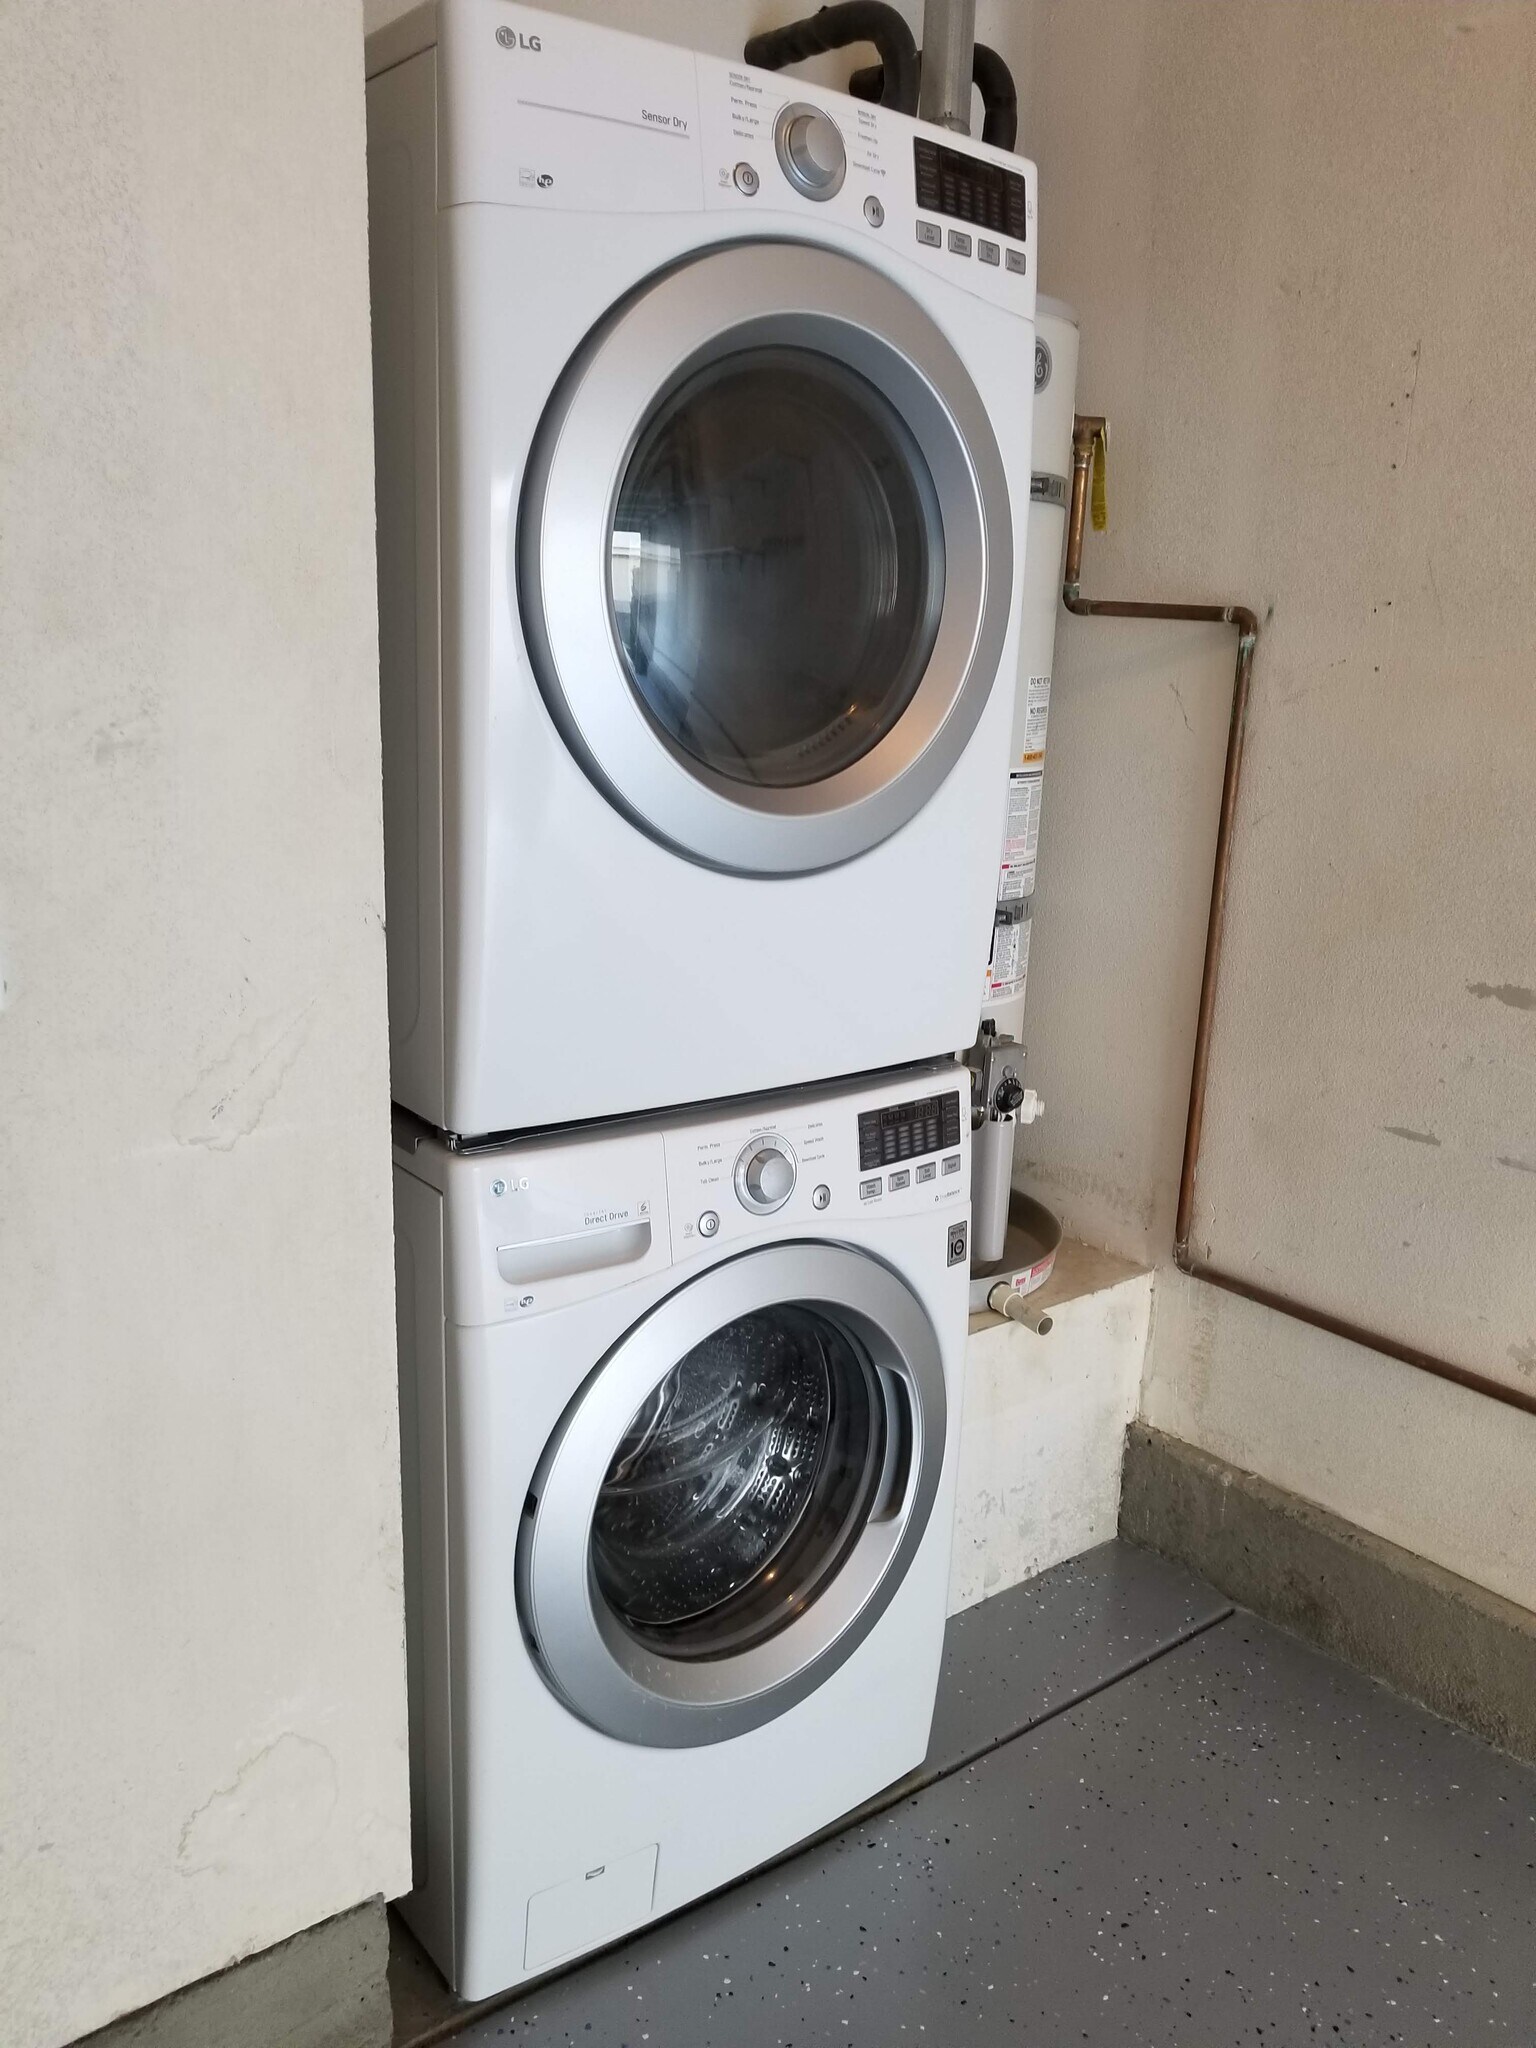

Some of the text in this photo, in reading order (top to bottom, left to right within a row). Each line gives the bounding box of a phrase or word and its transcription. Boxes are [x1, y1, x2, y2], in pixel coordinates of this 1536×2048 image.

[519, 32, 542, 52] LG
[641, 109, 688, 131] Sensor Dry
[510, 1177, 529, 1191] LG
[584, 1213, 608, 1226] Direct
[608, 1210, 629, 1222] Drive
[950, 1239, 964, 1258] 10
